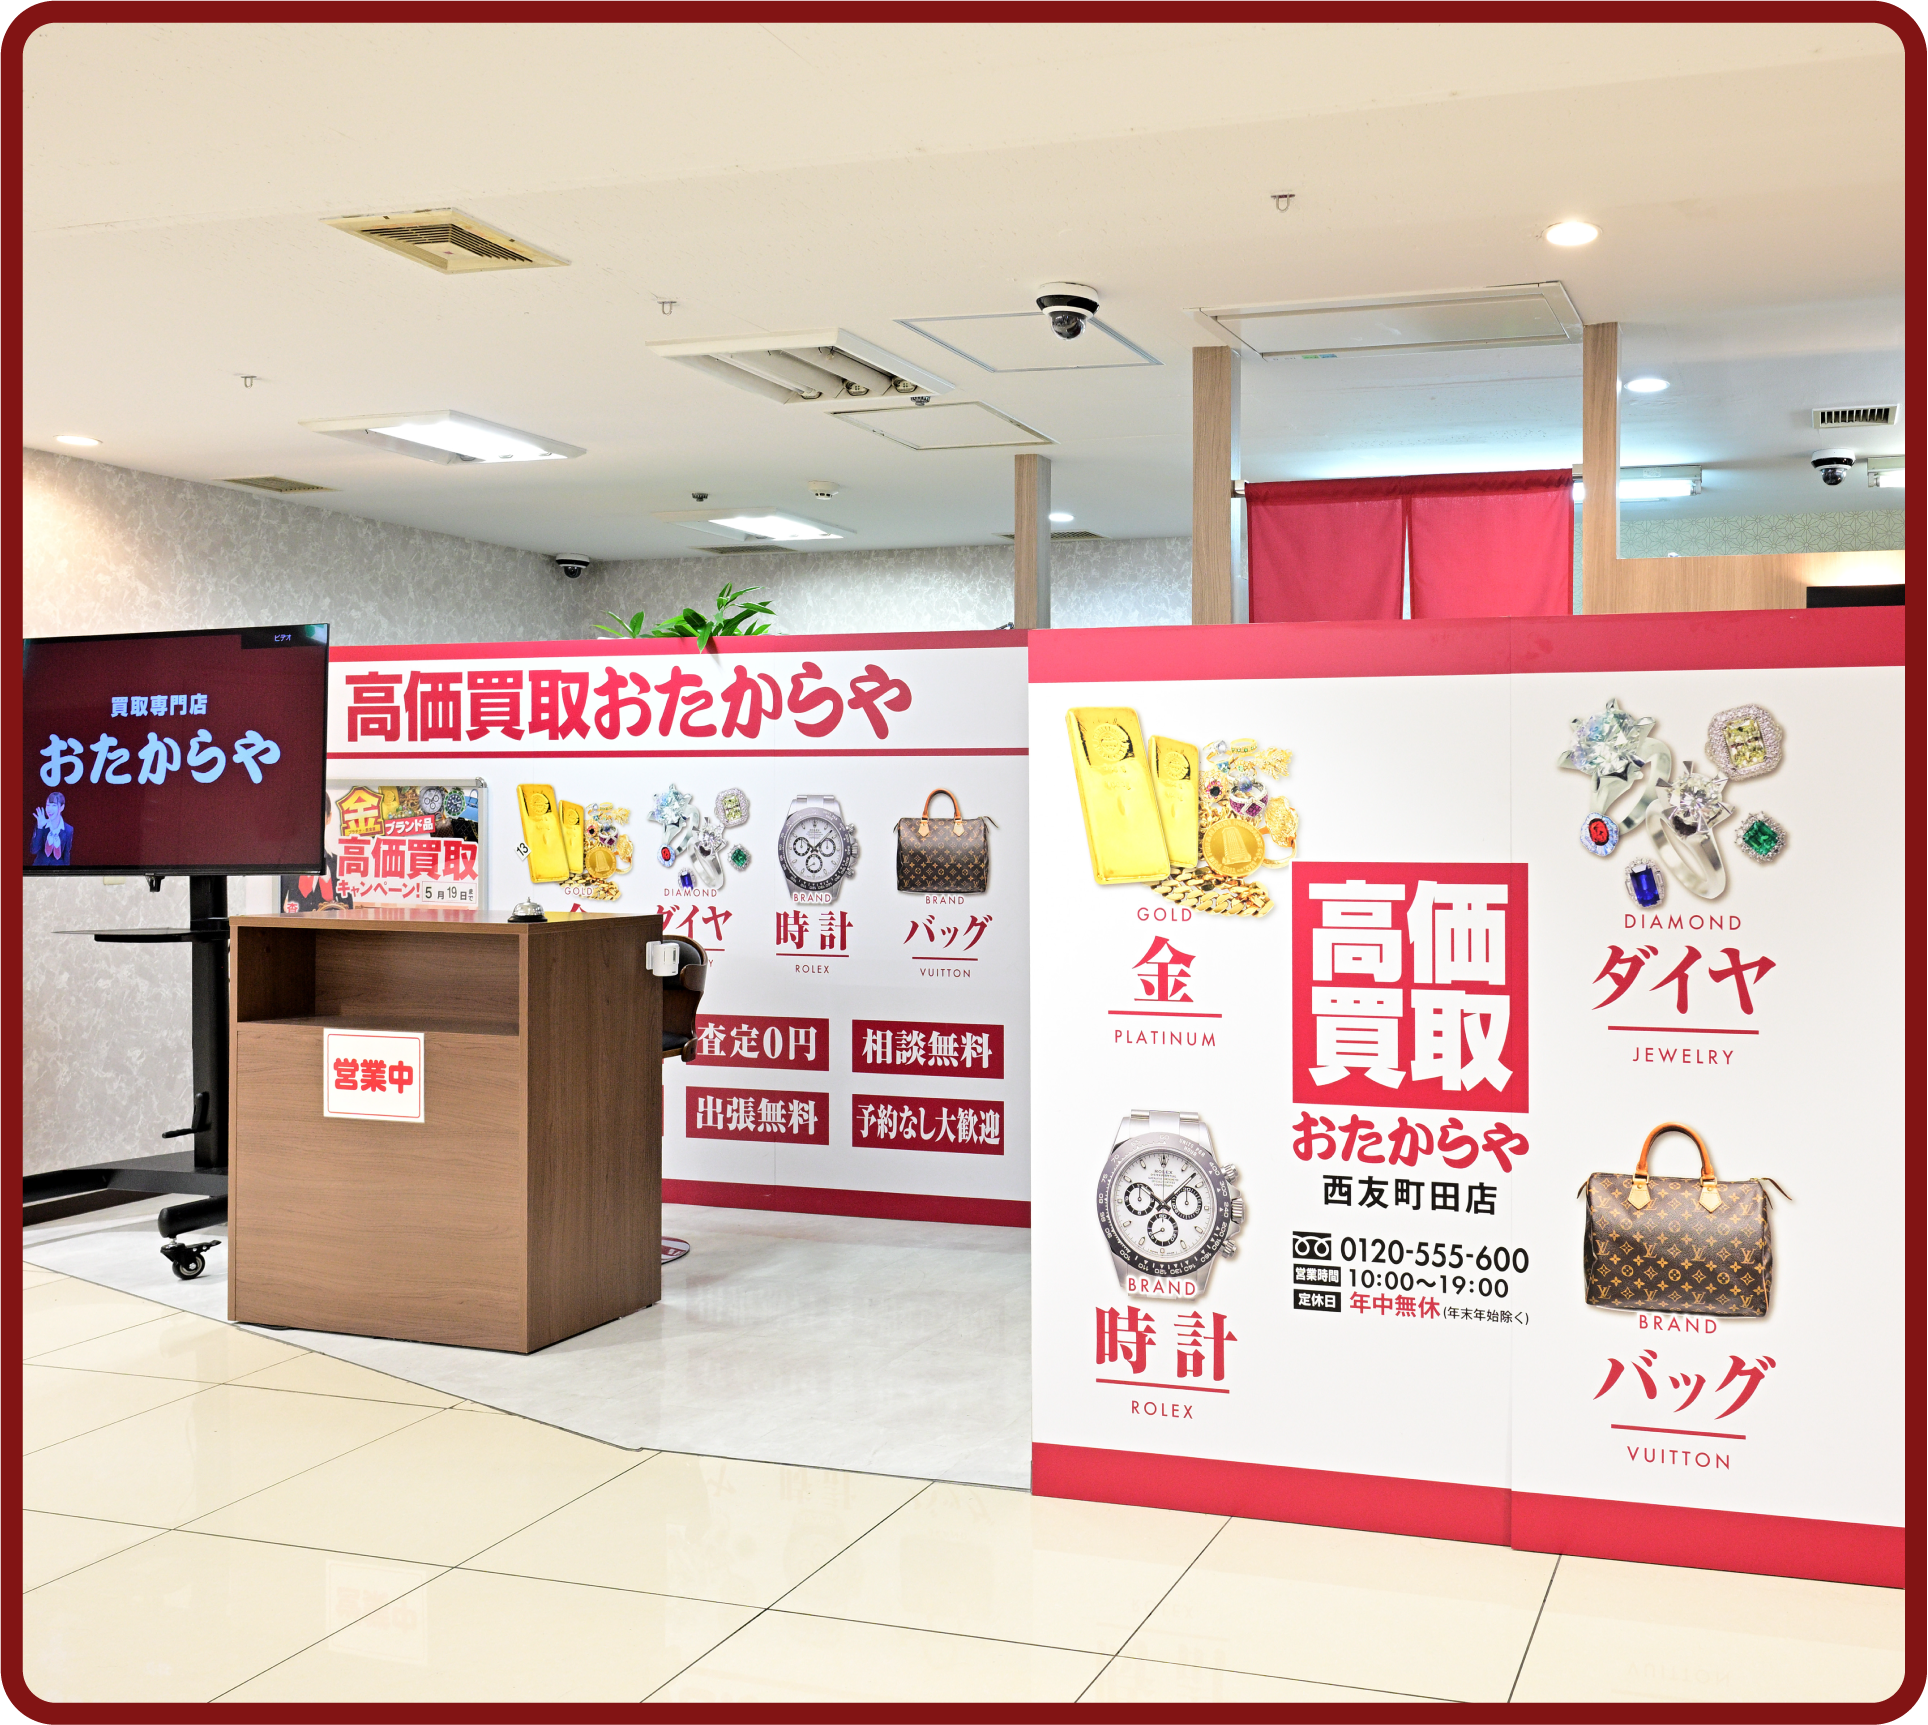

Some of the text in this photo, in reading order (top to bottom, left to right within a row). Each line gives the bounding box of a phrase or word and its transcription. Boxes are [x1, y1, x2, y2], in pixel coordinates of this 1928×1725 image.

[274, 633, 292, 642] ビデオ
[110, 692, 208, 718] 買取専門店
[345, 661, 913, 742] 高価買取おたからや
[39, 728, 281, 787] おたからや
[341, 790, 379, 830] 金
[385, 817, 434, 835] ブランド品
[338, 836, 479, 881] 高価買取
[516, 842, 529, 856] 13
[337, 880, 420, 898] キャンペーン!
[564, 886, 593, 896] GOLD
[664, 887, 718, 898] DIAMOND
[794, 893, 832, 904] BRAND
[925, 895, 965, 905] BRAND
[1137, 907, 1192, 922] GOLD
[1624, 913, 1742, 931] DIAMOND
[775, 909, 854, 951] 時計
[903, 914, 993, 952] バッグ
[1308, 879, 1509, 986] 高価
[795, 964, 830, 974] ROLEX
[920, 968, 971, 978] VUITTON
[1132, 935, 1197, 1003] 金
[1591, 944, 1777, 1016] ダイヤ
[862, 1027, 993, 1069] 相談無料
[1115, 1029, 1216, 1047] PLATINUM
[1308, 985, 1514, 1093] 買取
[1632, 1047, 1734, 1065] JEWELRY
[333, 1057, 414, 1095] 営業中
[696, 1095, 819, 1136] 出張無料
[856, 1103, 1001, 1146] 予約なし大歓迎
[1292, 1110, 1530, 1174] おたからや
[1322, 1174, 1498, 1216] 西友町田店
[1340, 1236, 1530, 1274] 0120-555-600
[1128, 1277, 1196, 1296] BRAND
[1295, 1267, 1340, 1283] 営業時間
[1298, 1292, 1337, 1309] 定休日
[1349, 1291, 1441, 1320] 年中無休
[1639, 1314, 1718, 1334] BRAND
[1095, 1305, 1238, 1382] 時計
[1592, 1348, 1777, 1421] バッグ
[1131, 1400, 1193, 1419] ROLEX
[1626, 1446, 1730, 1470] VUITTON
